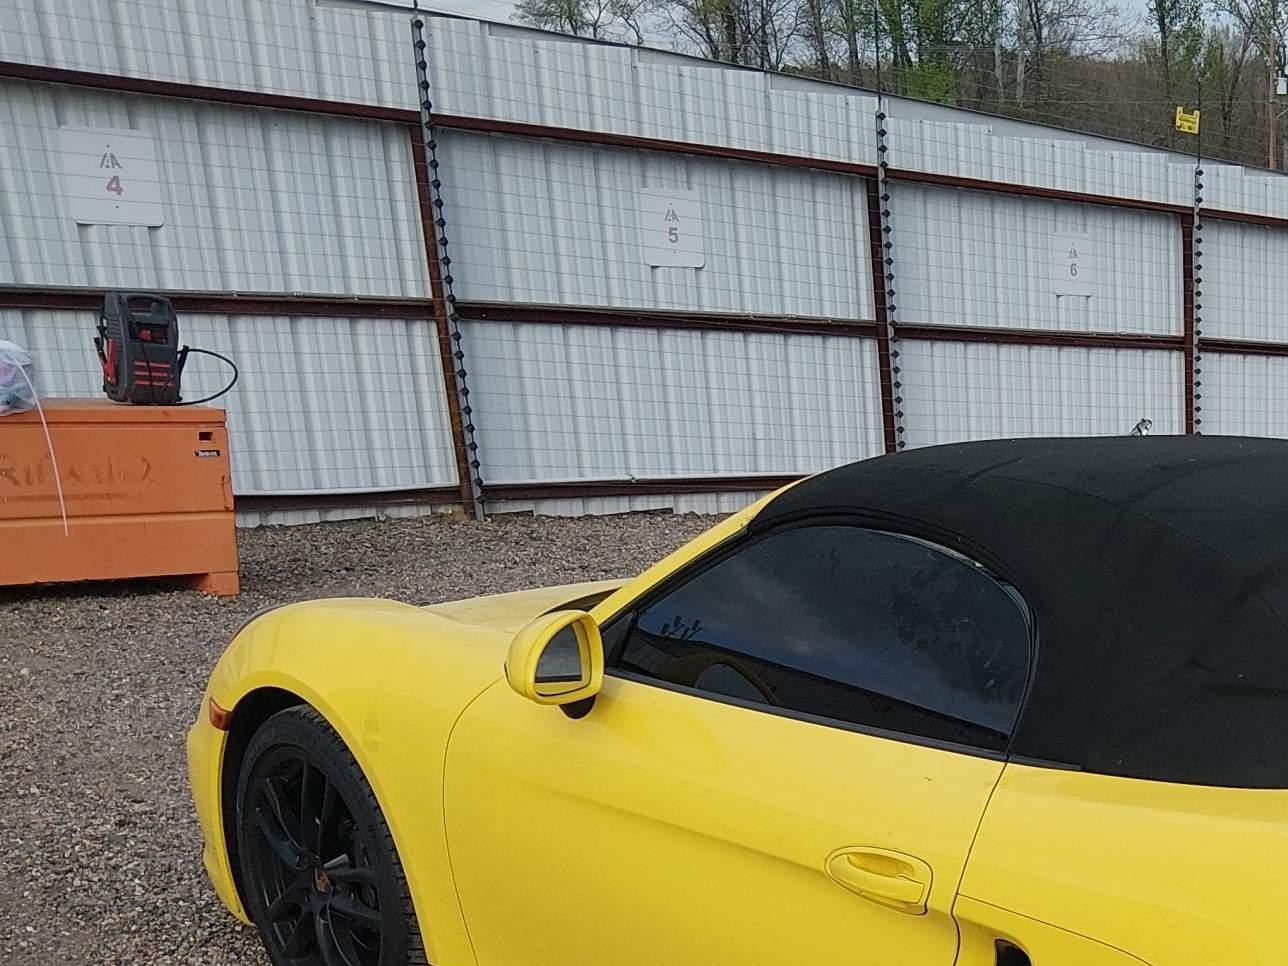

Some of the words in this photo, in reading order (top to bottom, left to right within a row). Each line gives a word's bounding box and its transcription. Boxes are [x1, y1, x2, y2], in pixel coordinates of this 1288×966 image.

[106, 175, 124, 196] 4
[668, 226, 679, 243] 5
[1070, 263, 1077, 277] 6
